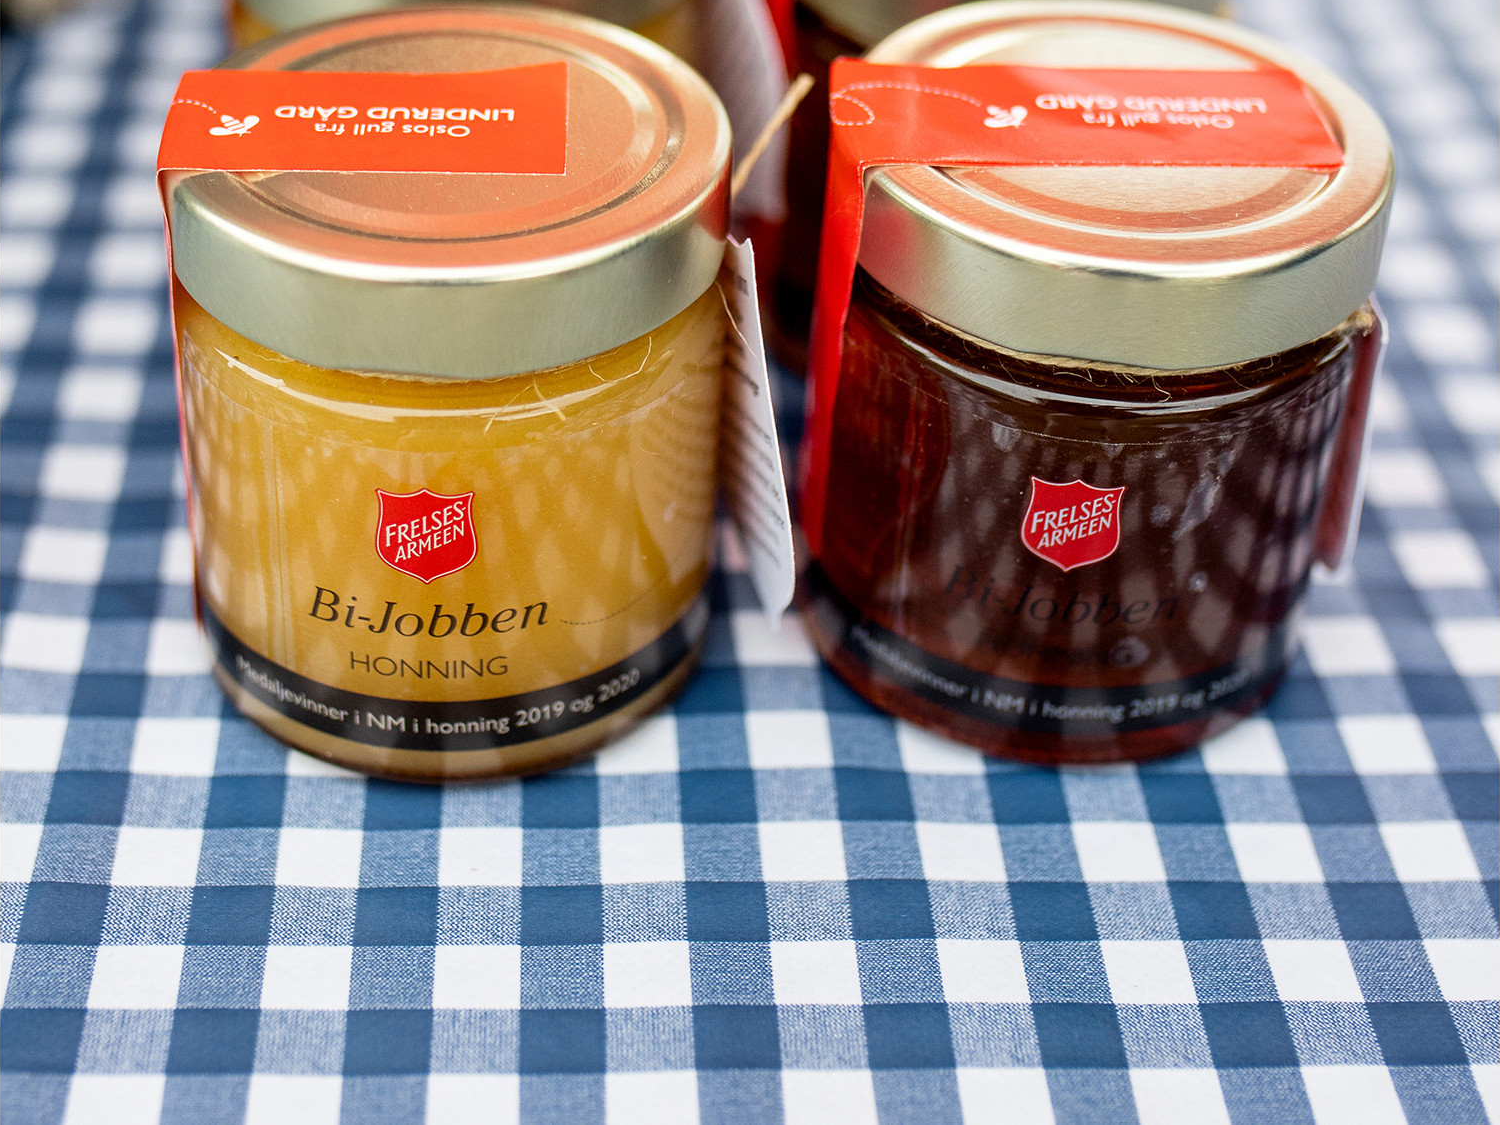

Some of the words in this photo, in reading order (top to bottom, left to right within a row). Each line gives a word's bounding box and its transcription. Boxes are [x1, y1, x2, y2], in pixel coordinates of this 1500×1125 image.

[1035, 93, 1118, 113] GÅRD
[1123, 95, 1267, 114] LINDERUD
[274, 105, 358, 122] GÅRD
[366, 106, 515, 122] LINDERUD
[1120, 111, 1160, 127] gull
[1166, 112, 1235, 129] Oslos
[314, 122, 345, 136] fra
[354, 121, 395, 137] gull
[402, 122, 471, 138] Oslos
[1030, 493, 1116, 534] FRELSES-
[385, 501, 467, 547] FRELSES-
[1036, 513, 1113, 550] ARMEEN
[394, 521, 465, 563] ARMEEN
[307, 585, 549, 638] Bi-Jobben
[349, 651, 509, 679] HONNING
[235, 654, 349, 722] Medaljevinner
[353, 710, 361, 726] i
[366, 712, 406, 733] NM
[411, 718, 420, 734] i
[425, 717, 511, 735] honning
[514, 701, 566, 728] 2019
[569, 693, 595, 715] og
[598, 667, 641, 704] 2020
[983, 689, 1026, 715] NM
[1041, 700, 1127, 724] honning
[1129, 693, 1179, 719] 2019
